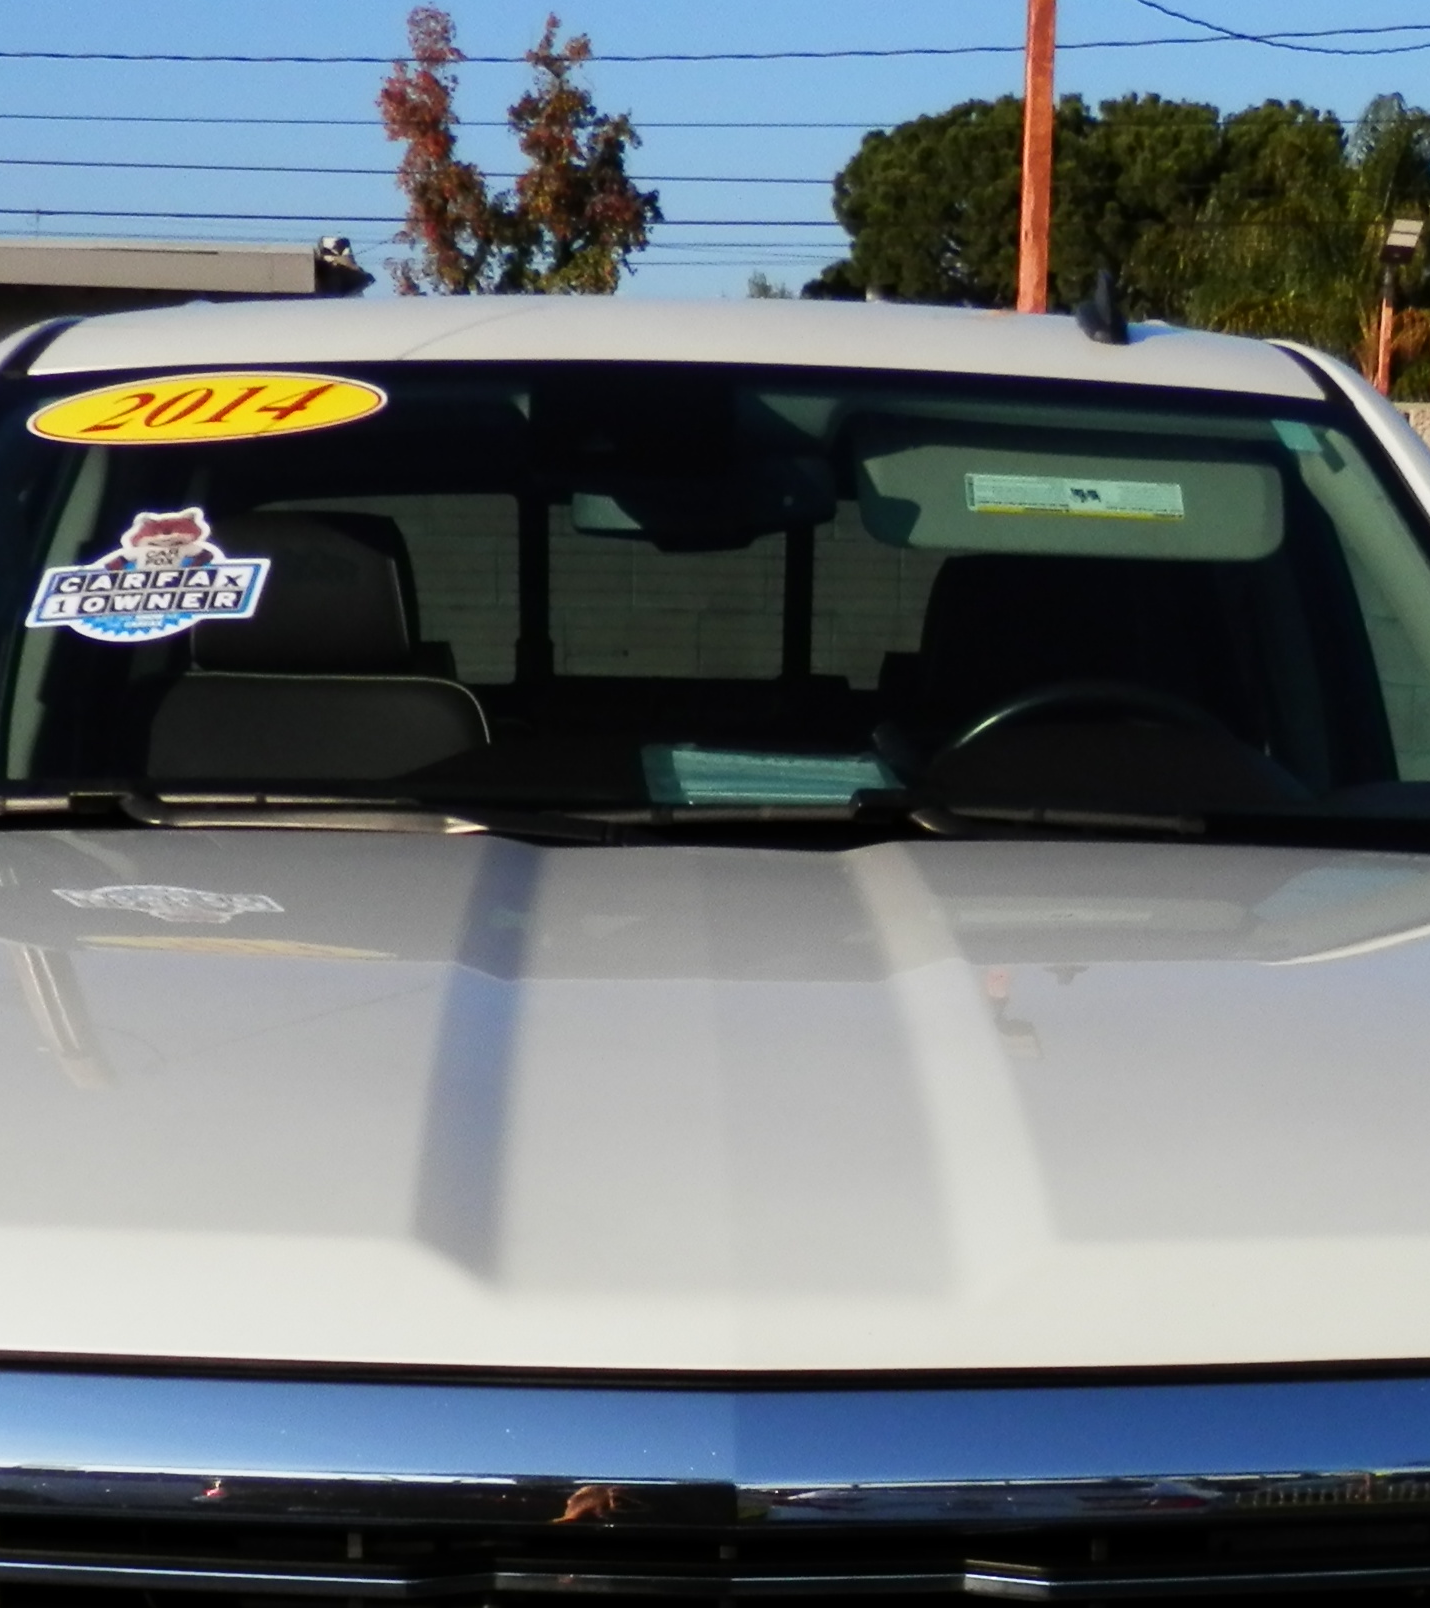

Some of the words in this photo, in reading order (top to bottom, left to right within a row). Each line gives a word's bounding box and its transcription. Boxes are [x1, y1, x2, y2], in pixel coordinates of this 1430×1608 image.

[79, 383, 338, 433] 2014
[59, 570, 244, 593] CARFAX
[80, 592, 239, 614] OWNER
